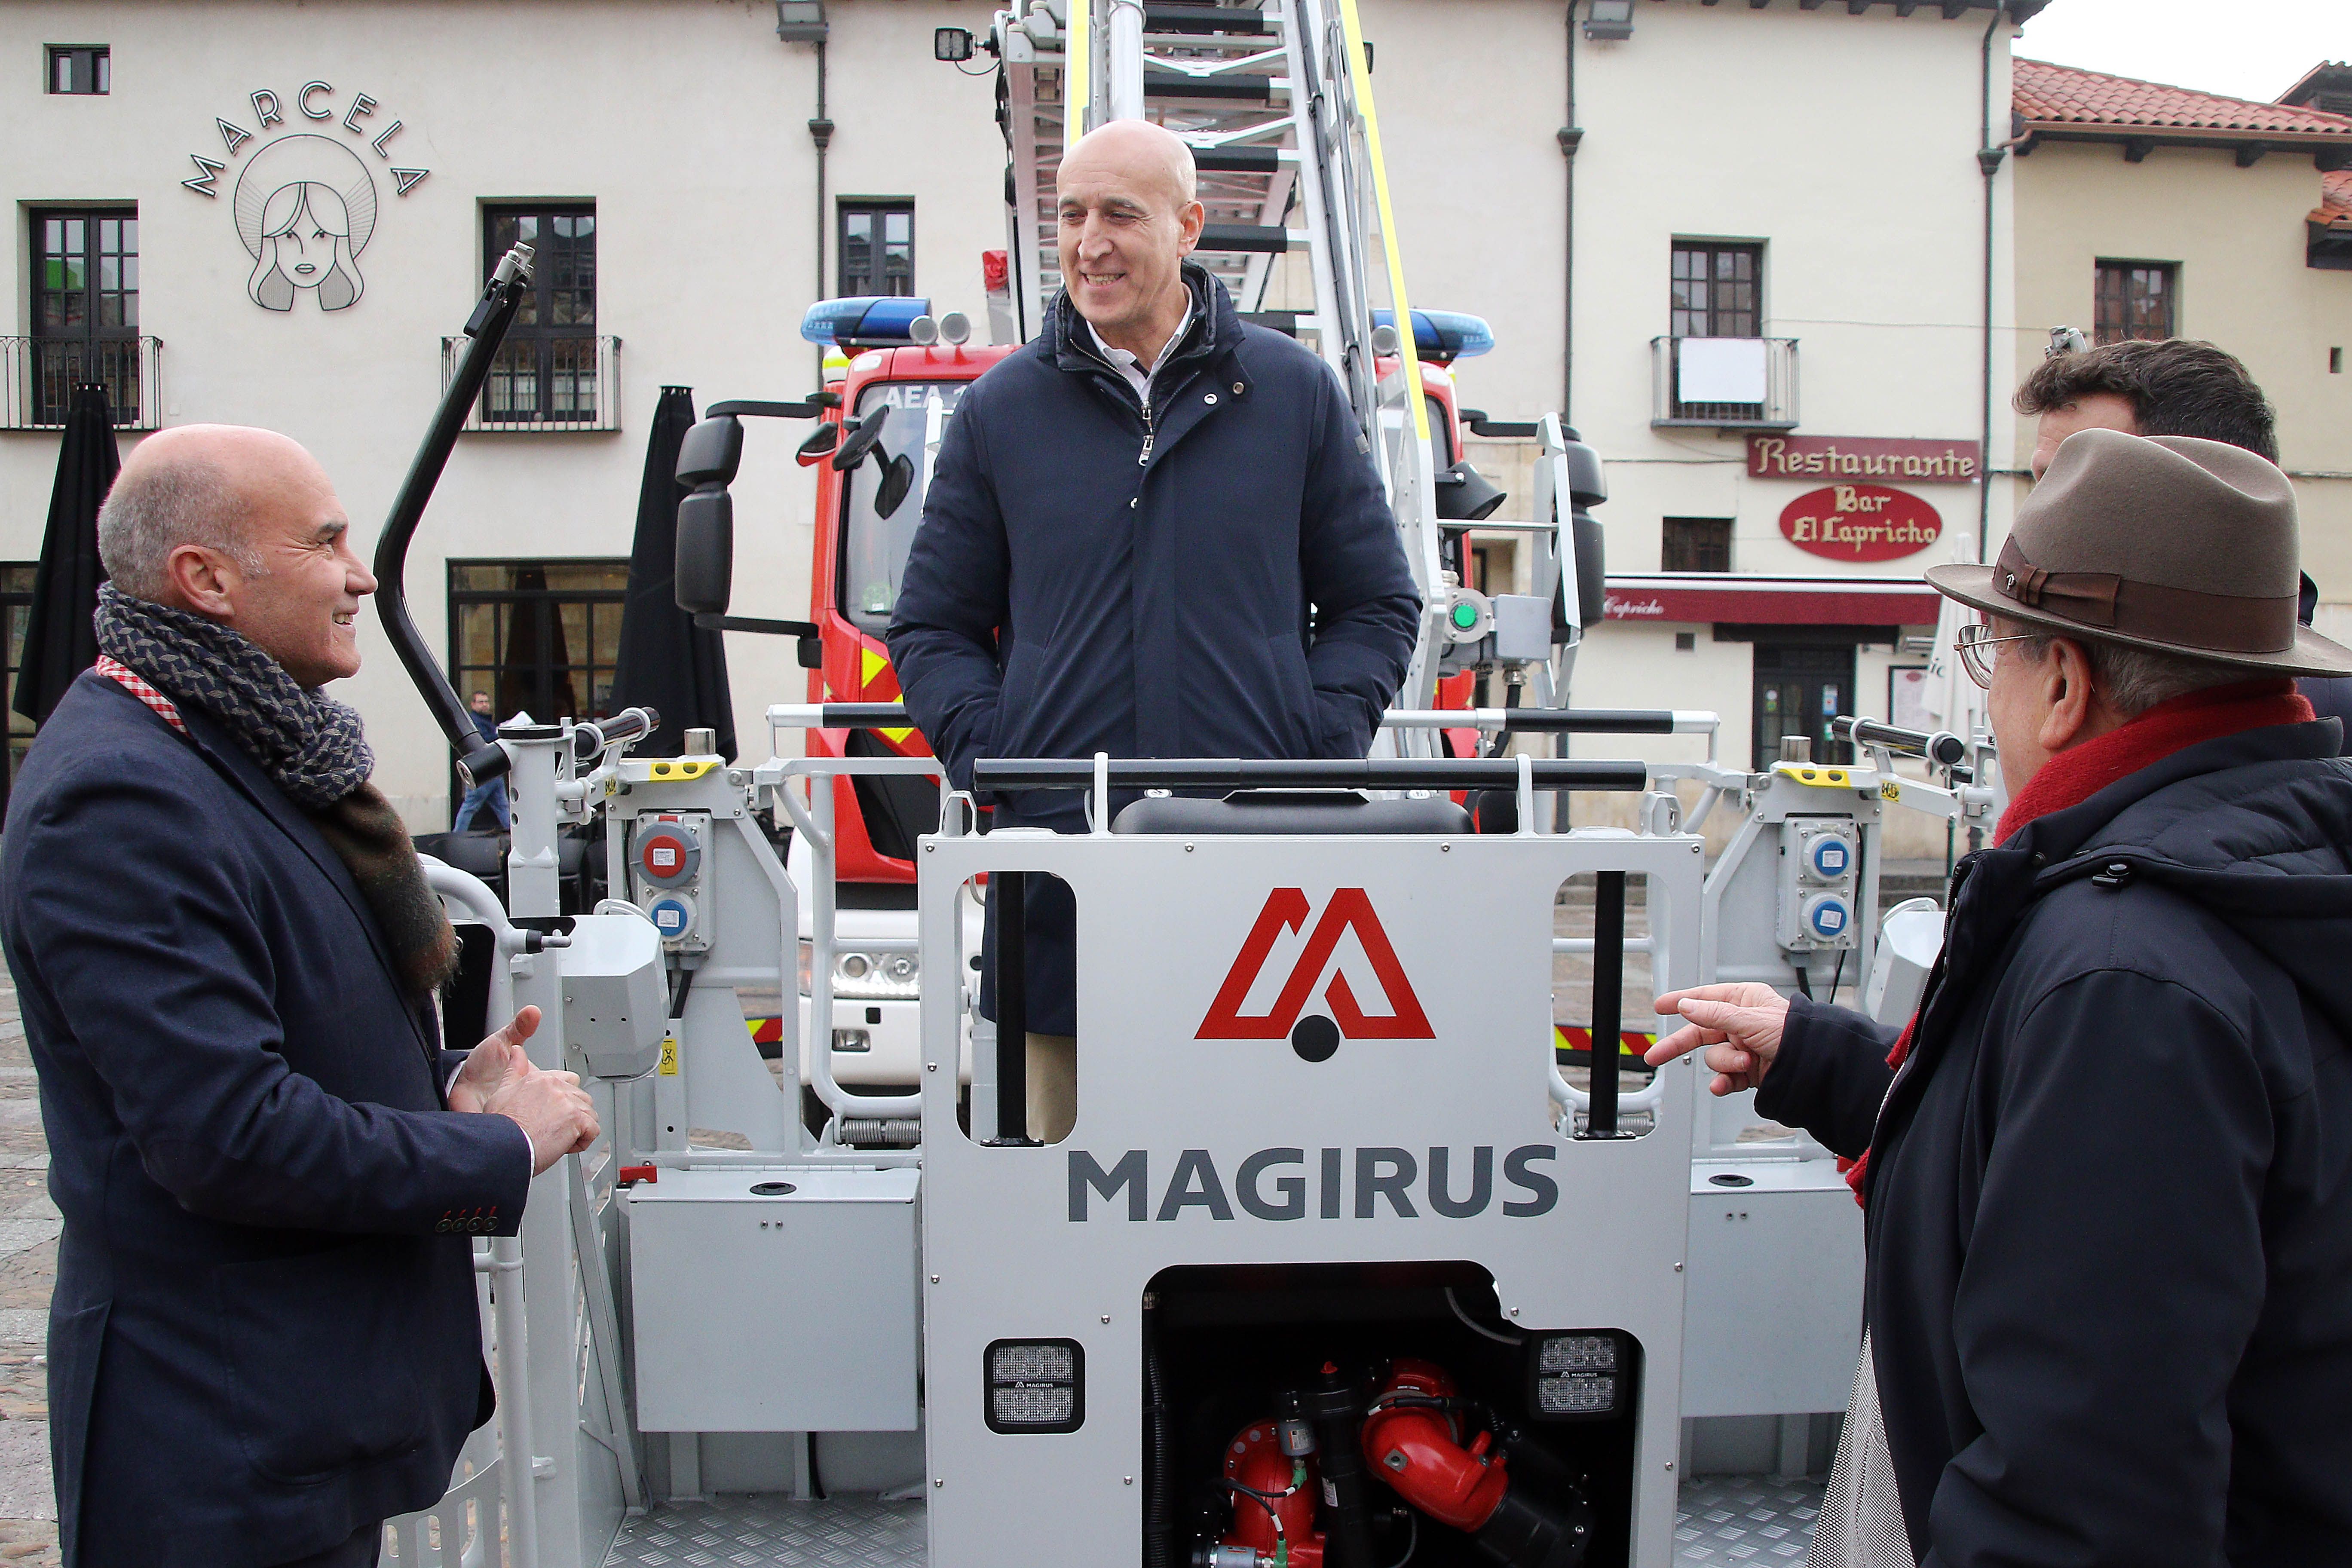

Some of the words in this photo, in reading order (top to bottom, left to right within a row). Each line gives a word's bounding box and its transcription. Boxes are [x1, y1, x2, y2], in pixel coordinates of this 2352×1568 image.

[181, 80, 429, 197] MARCELA
[1755, 438, 1974, 477] Restaurante
[1834, 486, 1891, 512] Bar
[1792, 516, 1817, 542] El
[1821, 516, 1936, 552] Capricho
[1068, 1145, 1559, 1222] MAGIRUS
